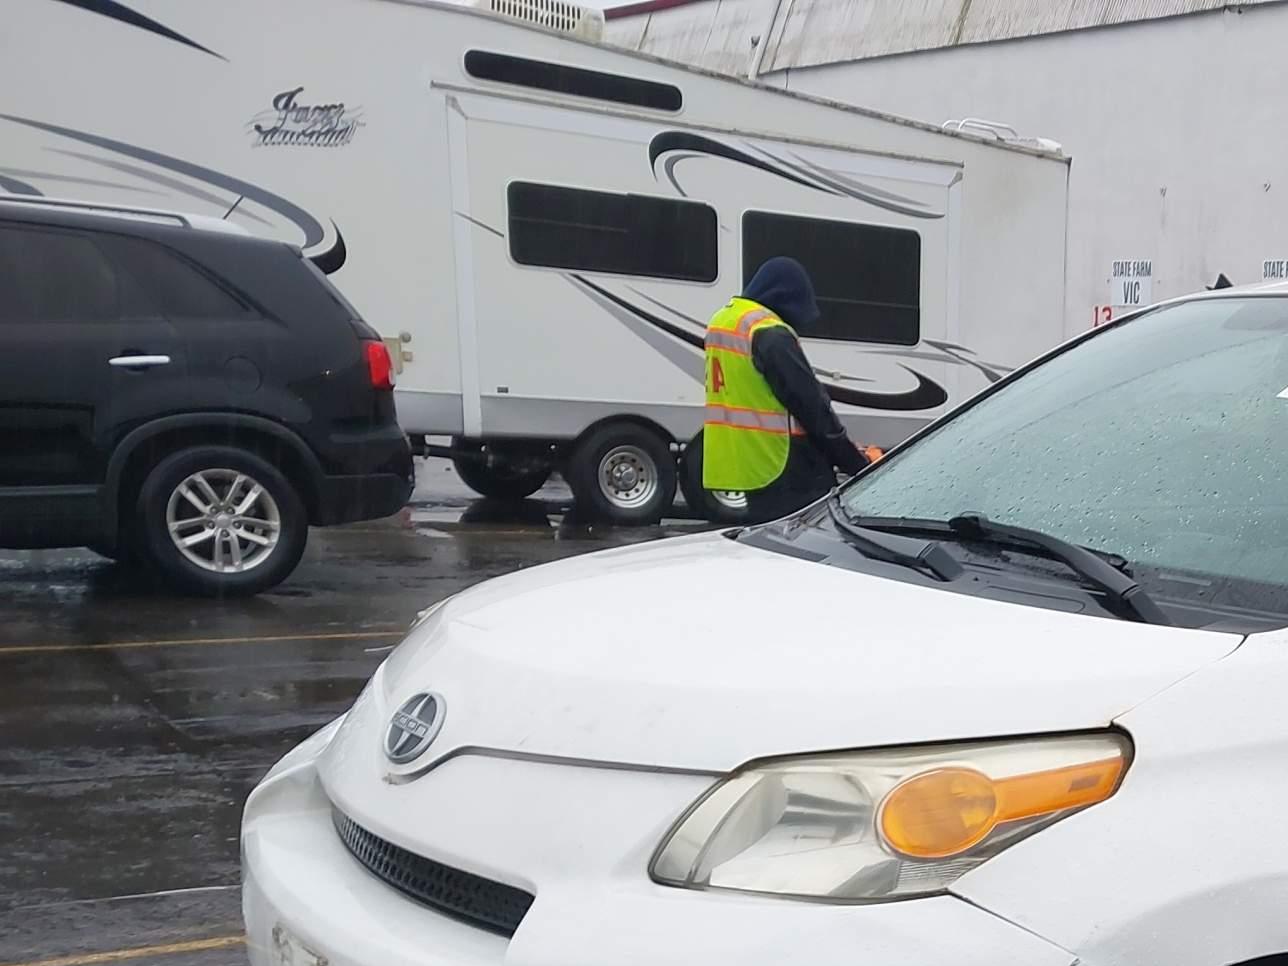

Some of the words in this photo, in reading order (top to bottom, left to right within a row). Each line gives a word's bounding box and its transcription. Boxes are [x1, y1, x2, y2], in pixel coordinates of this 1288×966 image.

[1112, 261, 1131, 277] STATE
[1132, 261, 1152, 277] FARM
[1263, 260, 1284, 278] STATE
[1123, 281, 1140, 304] VIC
